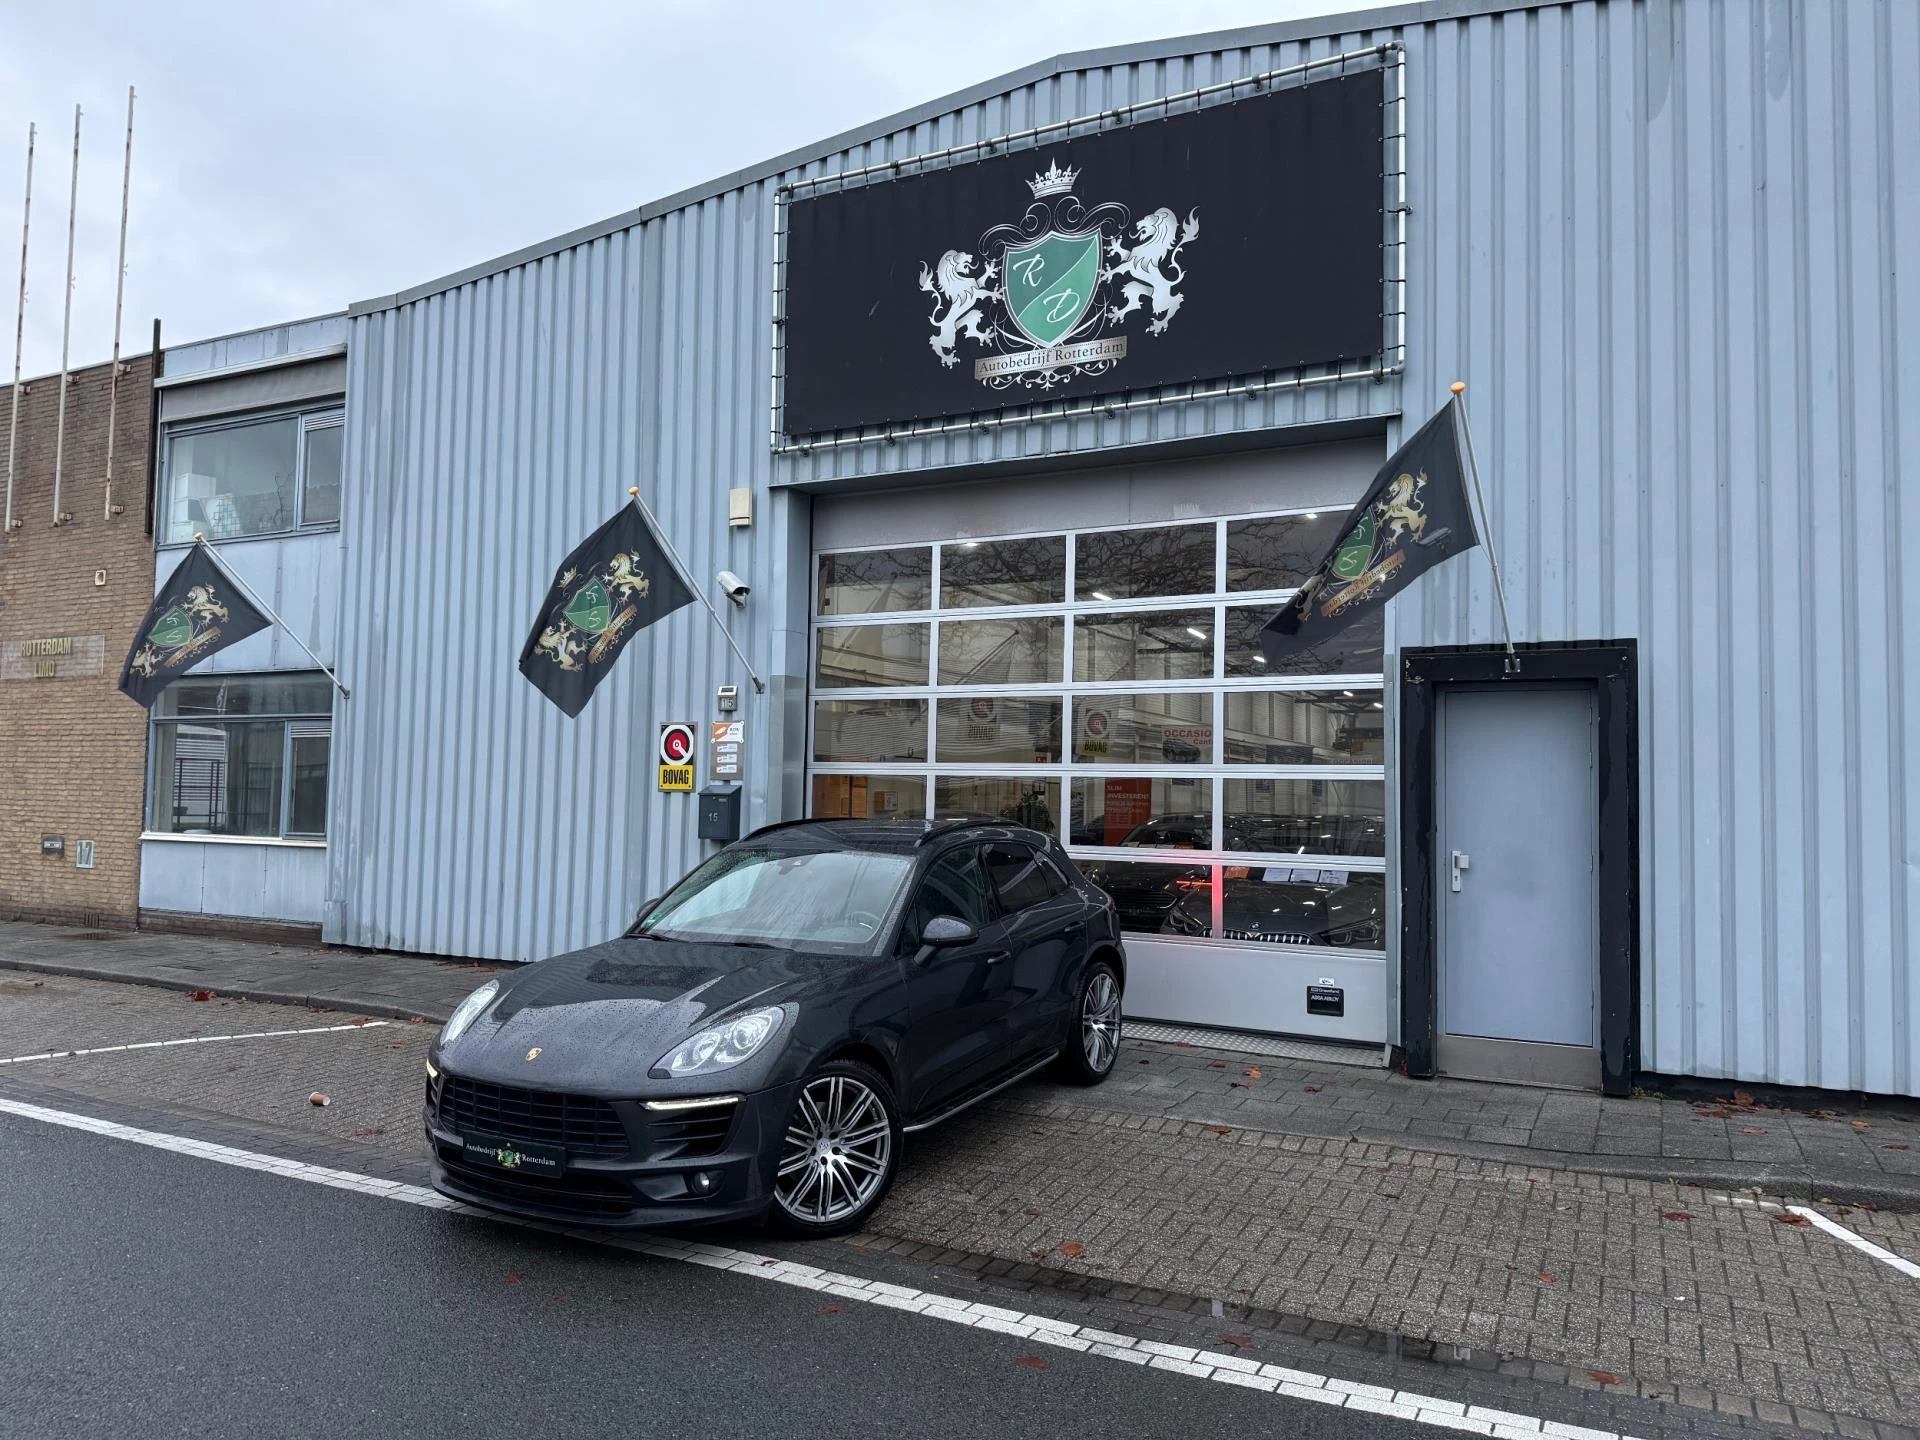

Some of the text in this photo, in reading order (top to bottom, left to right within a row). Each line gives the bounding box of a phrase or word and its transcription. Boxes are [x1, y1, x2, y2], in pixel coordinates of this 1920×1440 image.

[1013, 254, 1045, 287] R
[1043, 288, 1080, 323] D
[979, 342, 1124, 373] Autobedrijf Rotterdam
[21, 636, 72, 656] ROTTERDAM
[33, 660, 56, 677] LIMO
[662, 769, 689, 784] BOVAG
[708, 812, 718, 822] 15
[465, 1143, 556, 1166] Autobedrijf Rotterdam
